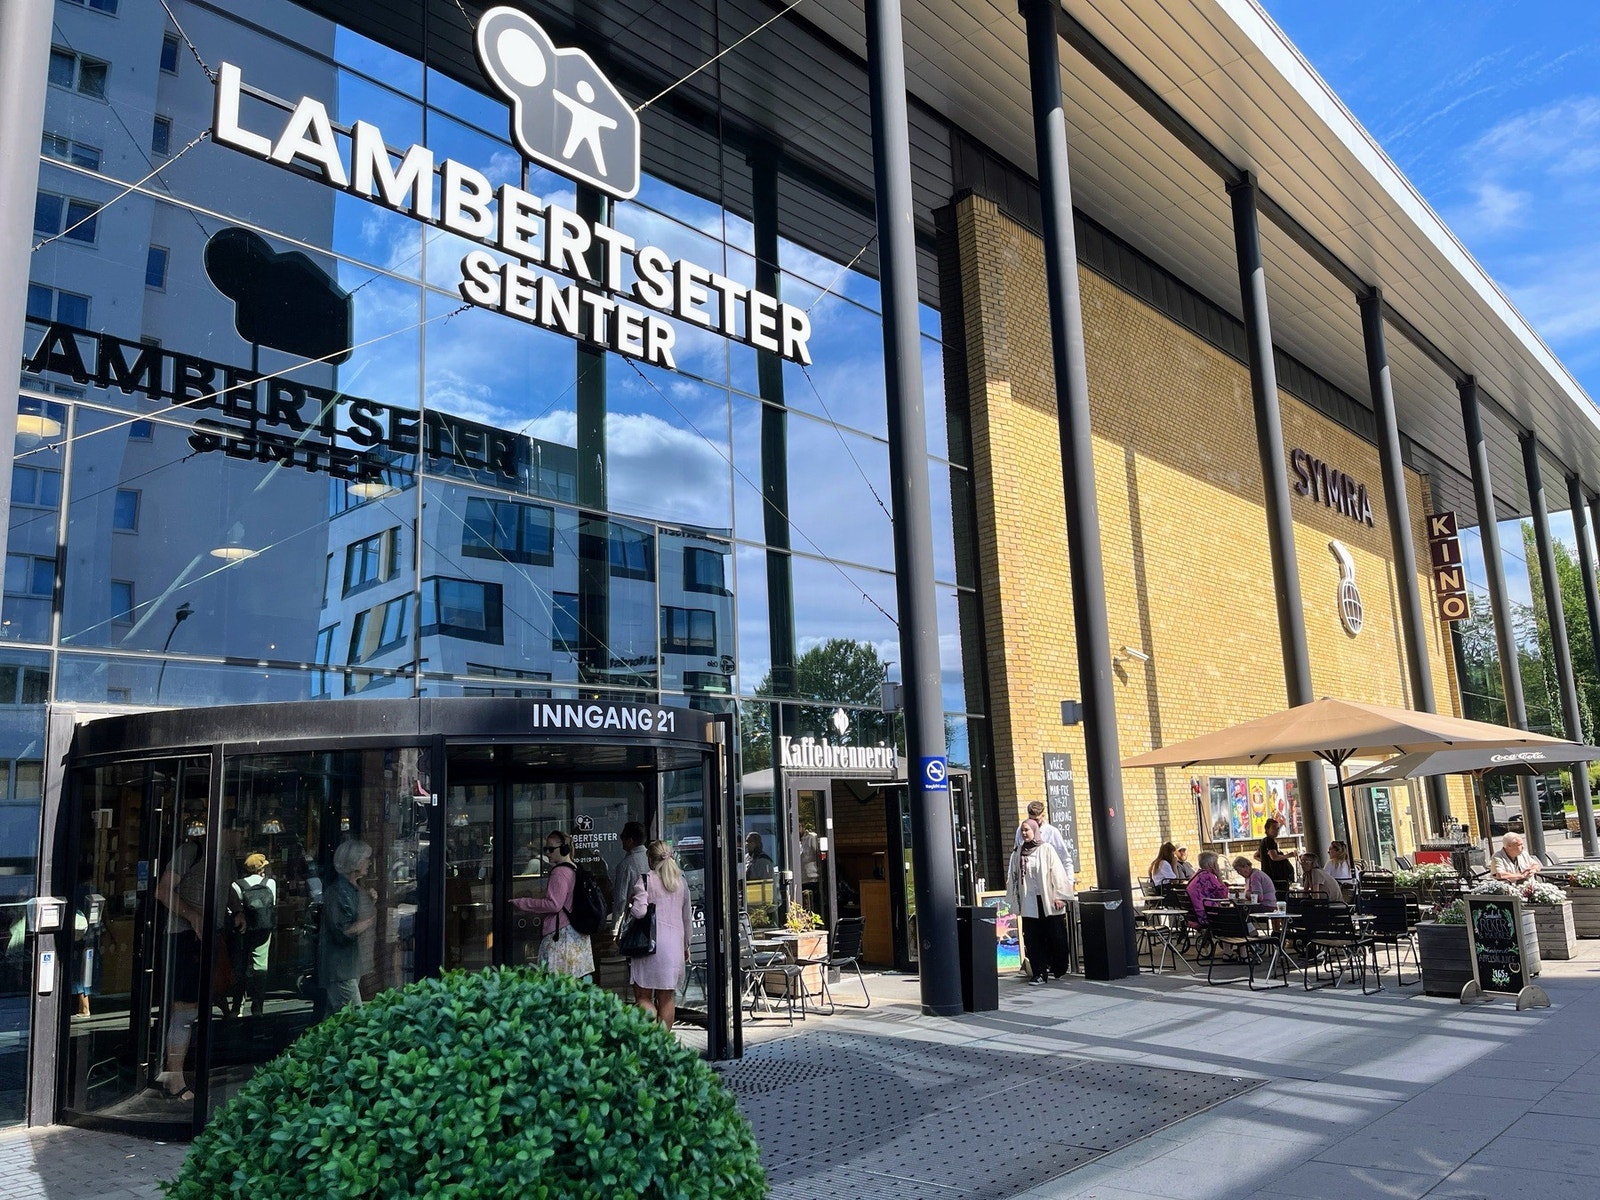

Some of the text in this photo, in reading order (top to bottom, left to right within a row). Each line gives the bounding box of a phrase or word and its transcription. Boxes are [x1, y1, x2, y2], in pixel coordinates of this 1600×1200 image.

[213, 62, 813, 366] LAMBERTSETER
[461, 250, 677, 370] SENTER
[23, 326, 518, 479] AMBERTSETER
[1291, 448, 1374, 528] SYMRA
[1432, 515, 1465, 617] KINO
[533, 703, 675, 733] INNGANG 21
[779, 735, 899, 769] Kaffebrenneriet
[572, 832, 618, 843] BERTSETER
[574, 841, 599, 849] SENTER
